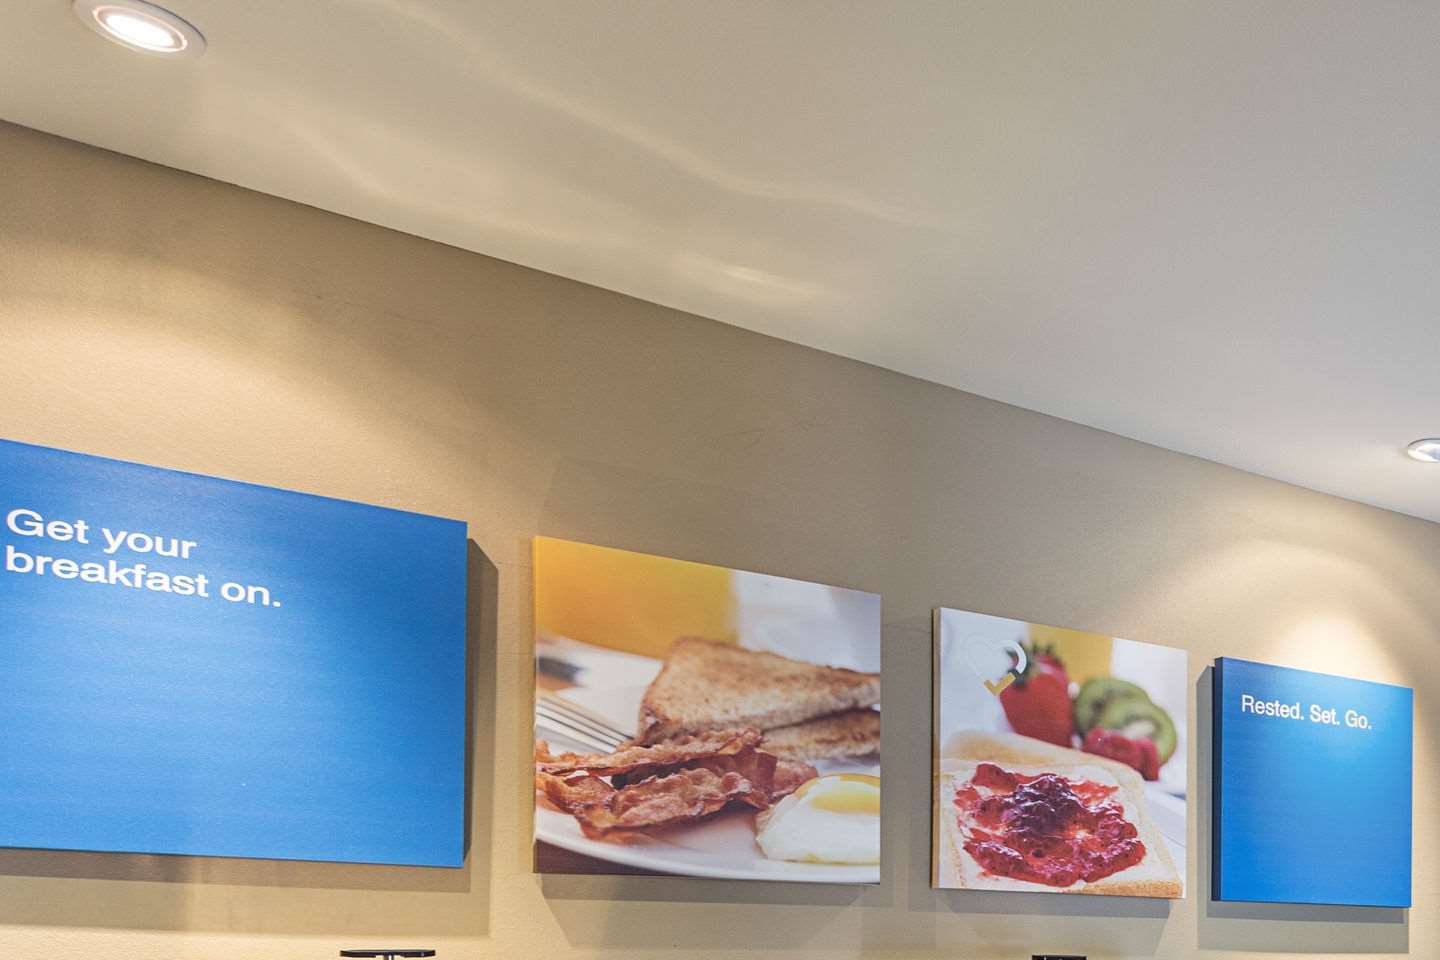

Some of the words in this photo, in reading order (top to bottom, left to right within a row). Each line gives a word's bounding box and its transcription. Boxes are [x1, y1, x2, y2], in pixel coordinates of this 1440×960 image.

[6, 508, 89, 544] Get
[101, 527, 198, 559] your
[5, 545, 209, 598] breakfast
[220, 582, 281, 608] on.
[1241, 694, 1305, 721] Rested.
[1309, 704, 1341, 726] Set.
[1345, 710, 1372, 730] Go.
